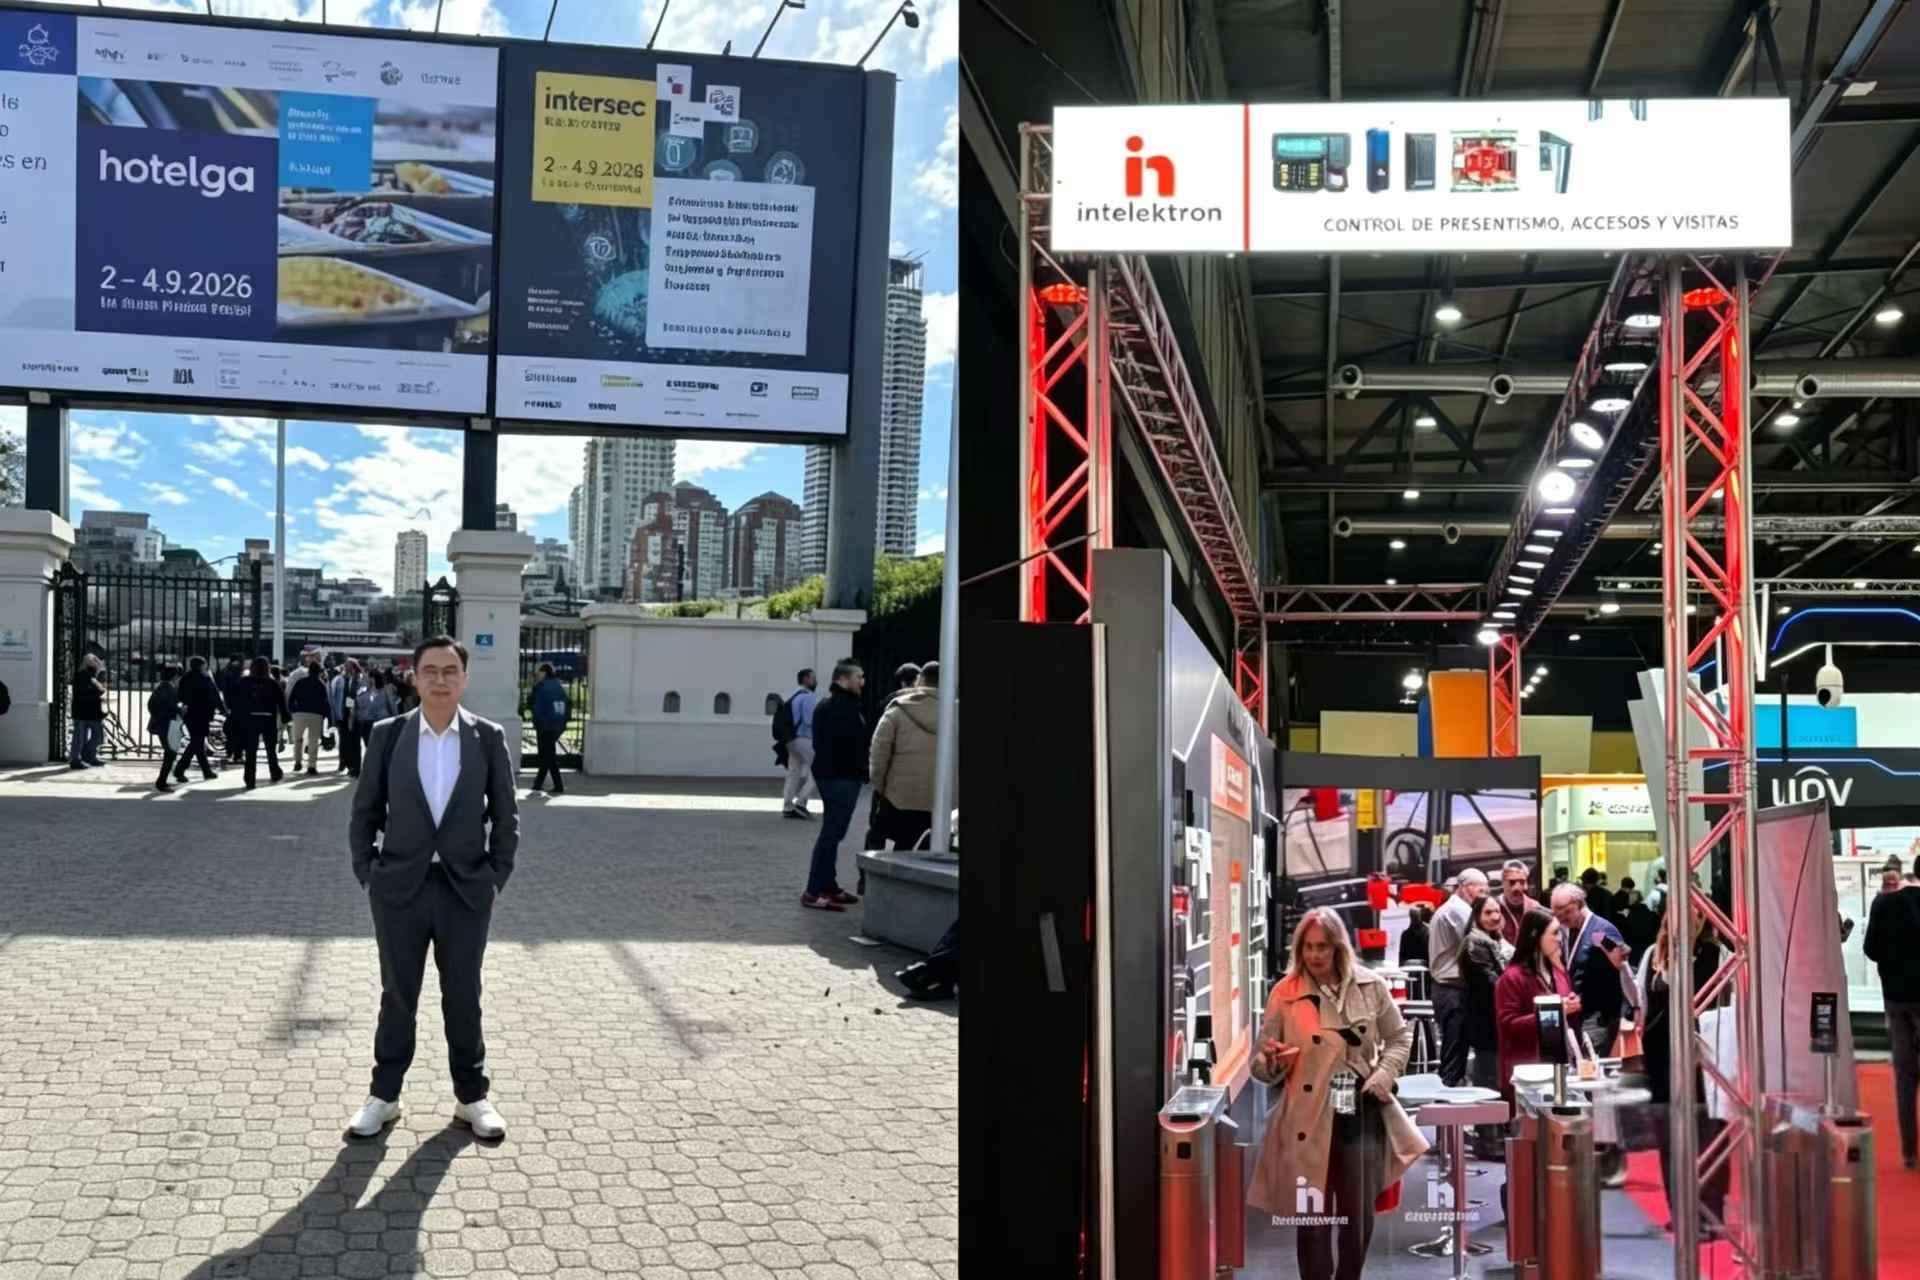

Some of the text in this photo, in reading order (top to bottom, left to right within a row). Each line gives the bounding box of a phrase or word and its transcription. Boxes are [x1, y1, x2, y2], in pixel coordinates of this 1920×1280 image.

[544, 86, 647, 117] intersec
[99, 148, 255, 198] hotelga
[543, 156, 555, 172] 2
[1125, 136, 1176, 197] in
[1077, 201, 1223, 223] intelektron
[1323, 214, 1740, 232] CONTROL DE PRESENTISMO, ACCESOS Y VISITAS
[99, 265, 117, 290] 2
[141, 267, 253, 299] 4.9.2026
